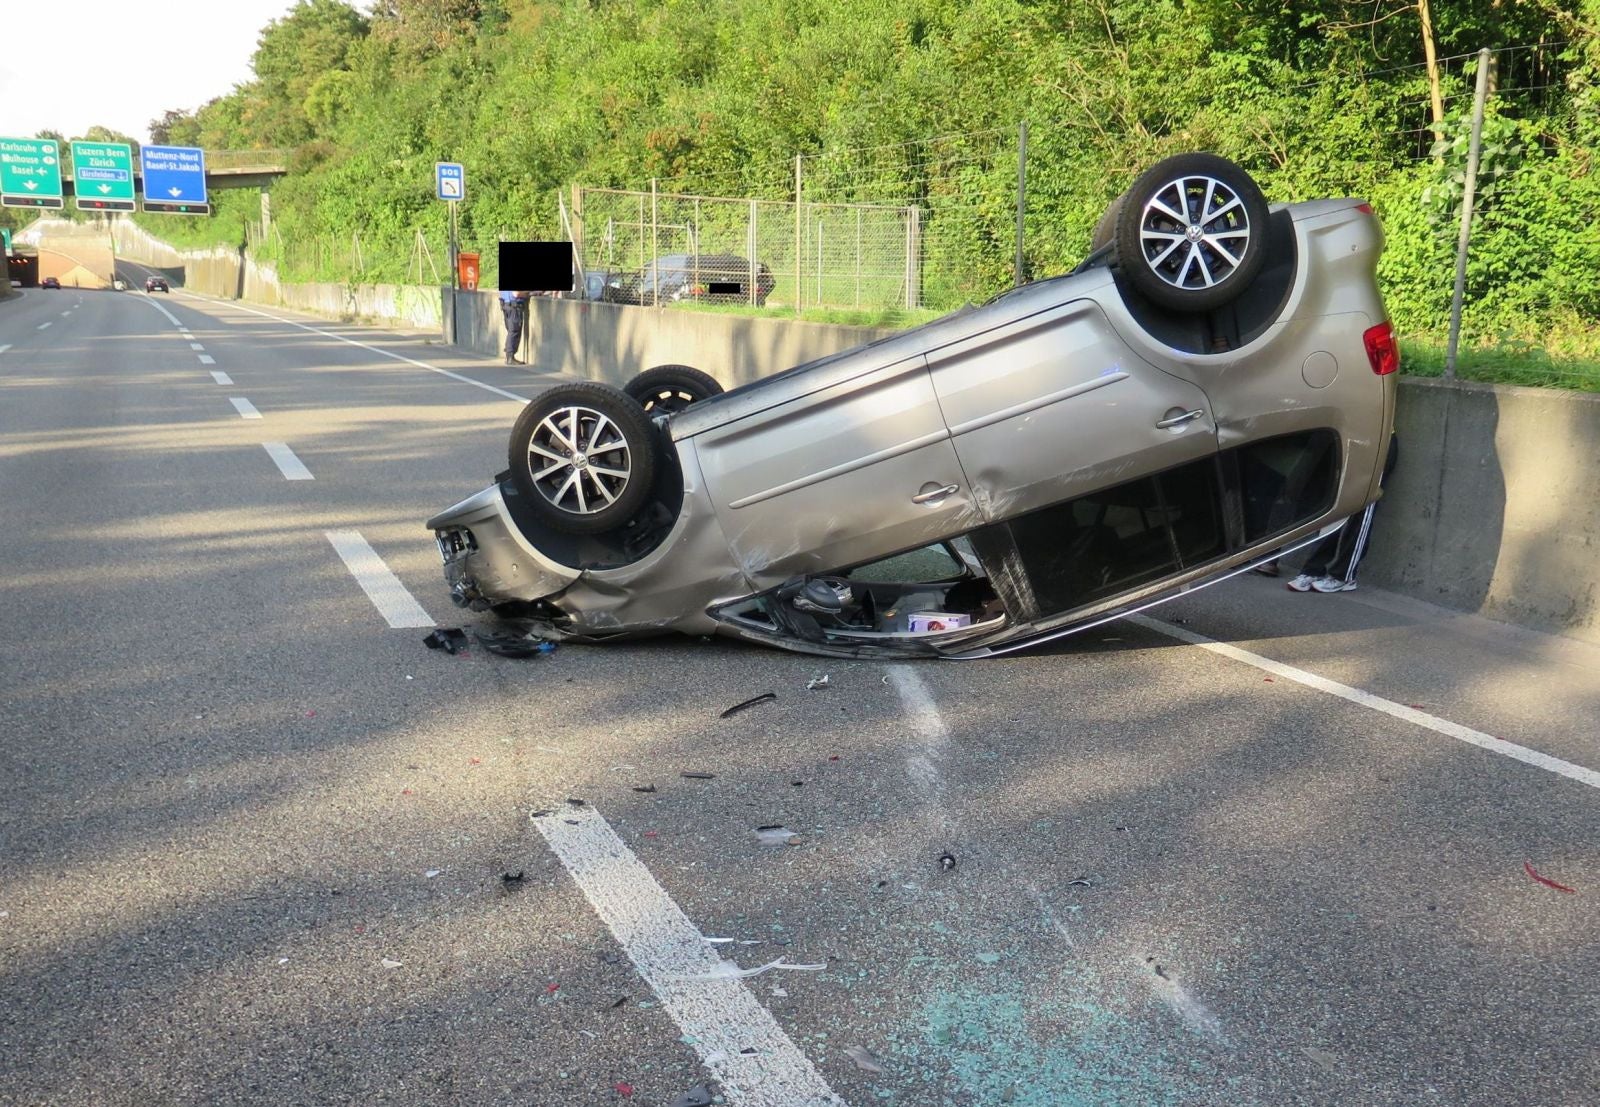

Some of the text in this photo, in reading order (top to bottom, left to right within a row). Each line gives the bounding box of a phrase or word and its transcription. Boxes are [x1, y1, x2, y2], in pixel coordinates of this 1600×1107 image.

[0, 143, 37, 153] Karlsruhe
[76, 146, 126, 157] Luzern Bern
[1, 153, 39, 164] Mulhouse
[145, 150, 199, 162] Muttenz-Nord
[89, 157, 115, 167] Zürich
[11, 165, 34, 175] Basel
[441, 168, 459, 176] SOS
[466, 266, 475, 290] SO
